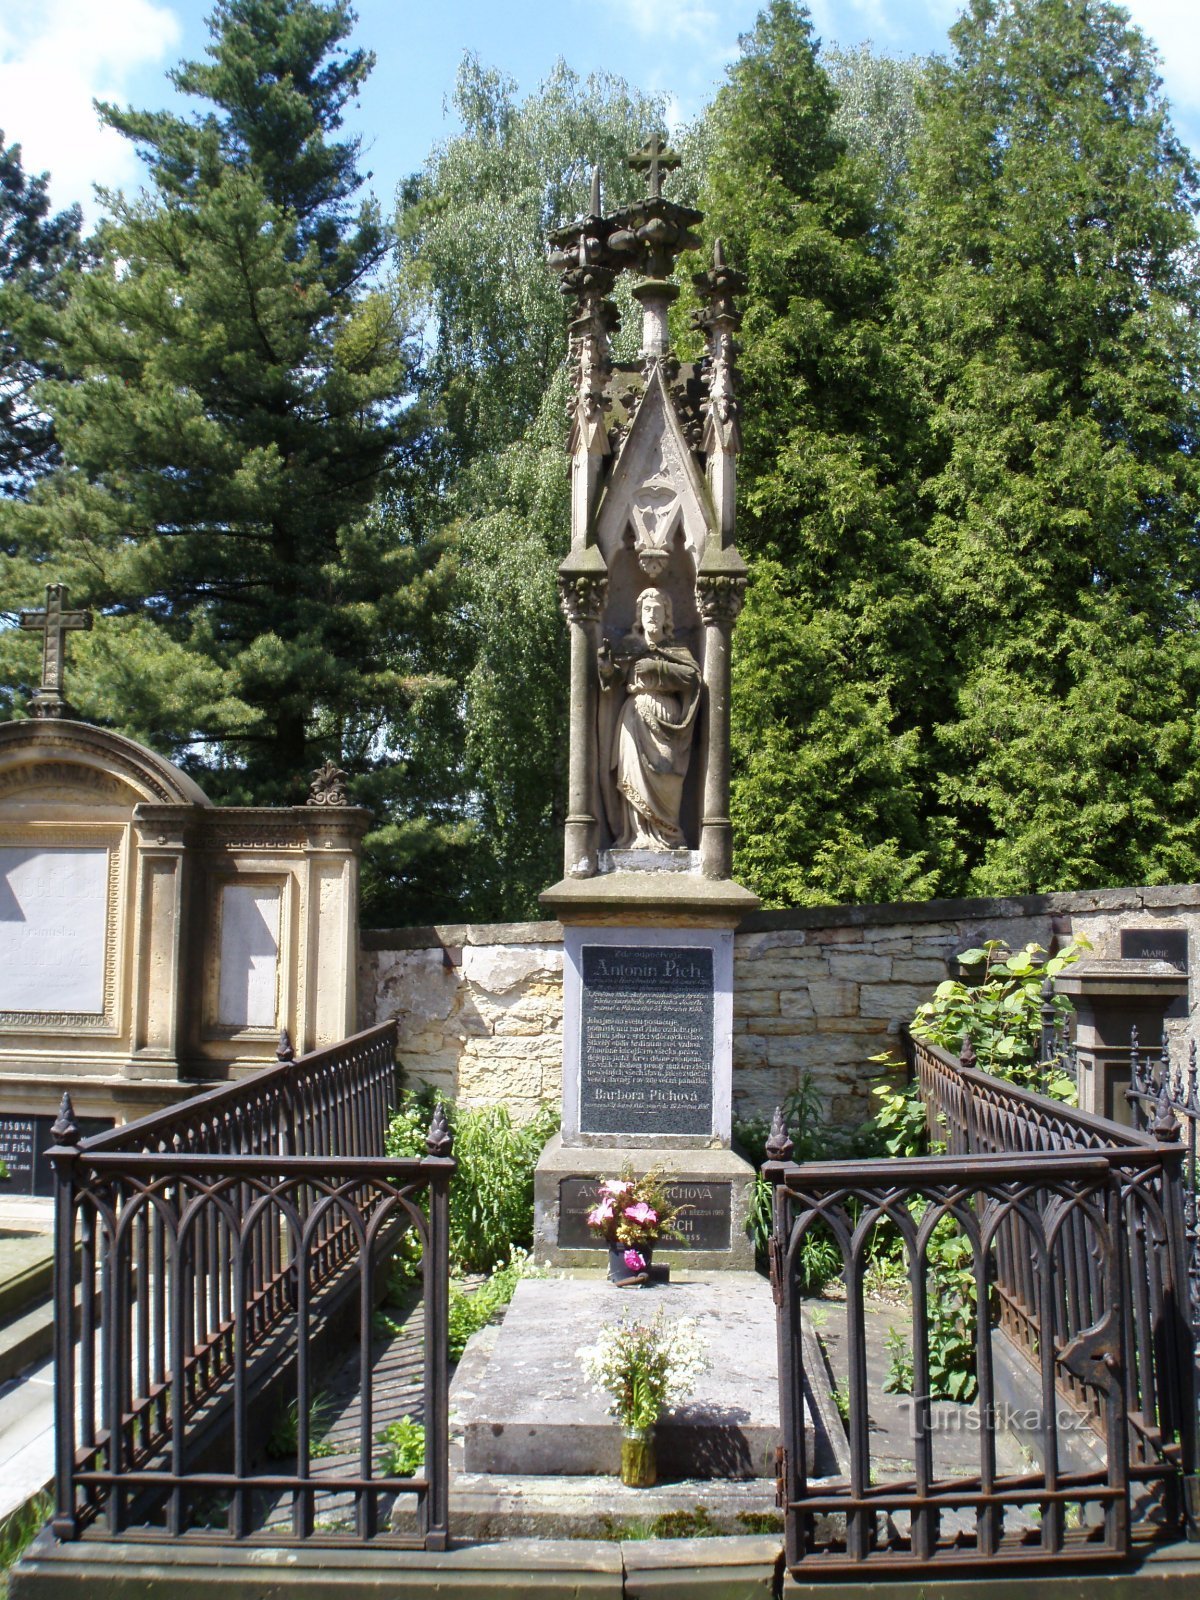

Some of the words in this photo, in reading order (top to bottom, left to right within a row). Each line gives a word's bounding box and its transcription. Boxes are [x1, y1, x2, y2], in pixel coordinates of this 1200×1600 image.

[1141, 949, 1169, 958] MARIE
[595, 1088, 645, 1100] Barbora
[650, 1089, 698, 1101] Pichová
[12, 1142, 31, 1153] FIŠA
